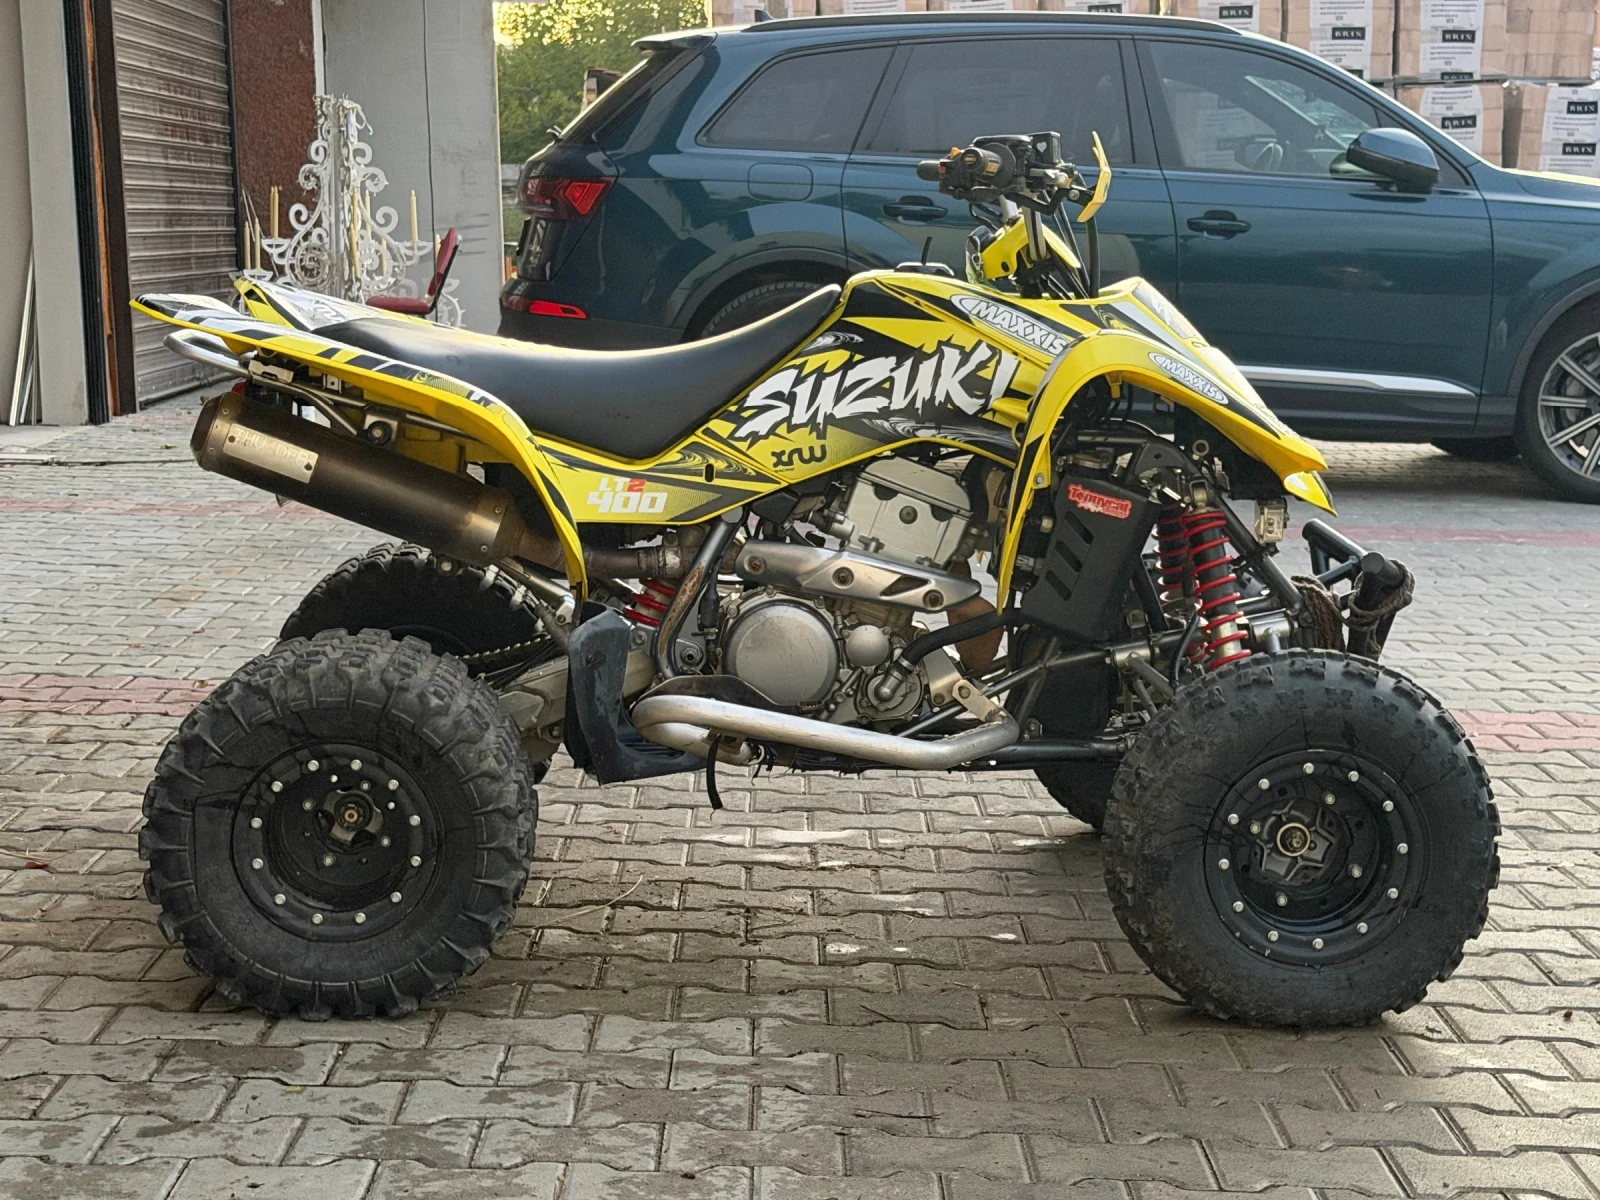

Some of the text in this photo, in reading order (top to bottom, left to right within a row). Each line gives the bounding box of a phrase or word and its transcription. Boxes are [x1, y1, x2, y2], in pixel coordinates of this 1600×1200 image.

[973, 301, 1070, 355] MAXXIS
[733, 342, 1020, 440] SUZUKI
[1161, 359, 1220, 398] MAXXIS
[586, 492, 668, 513] 400
